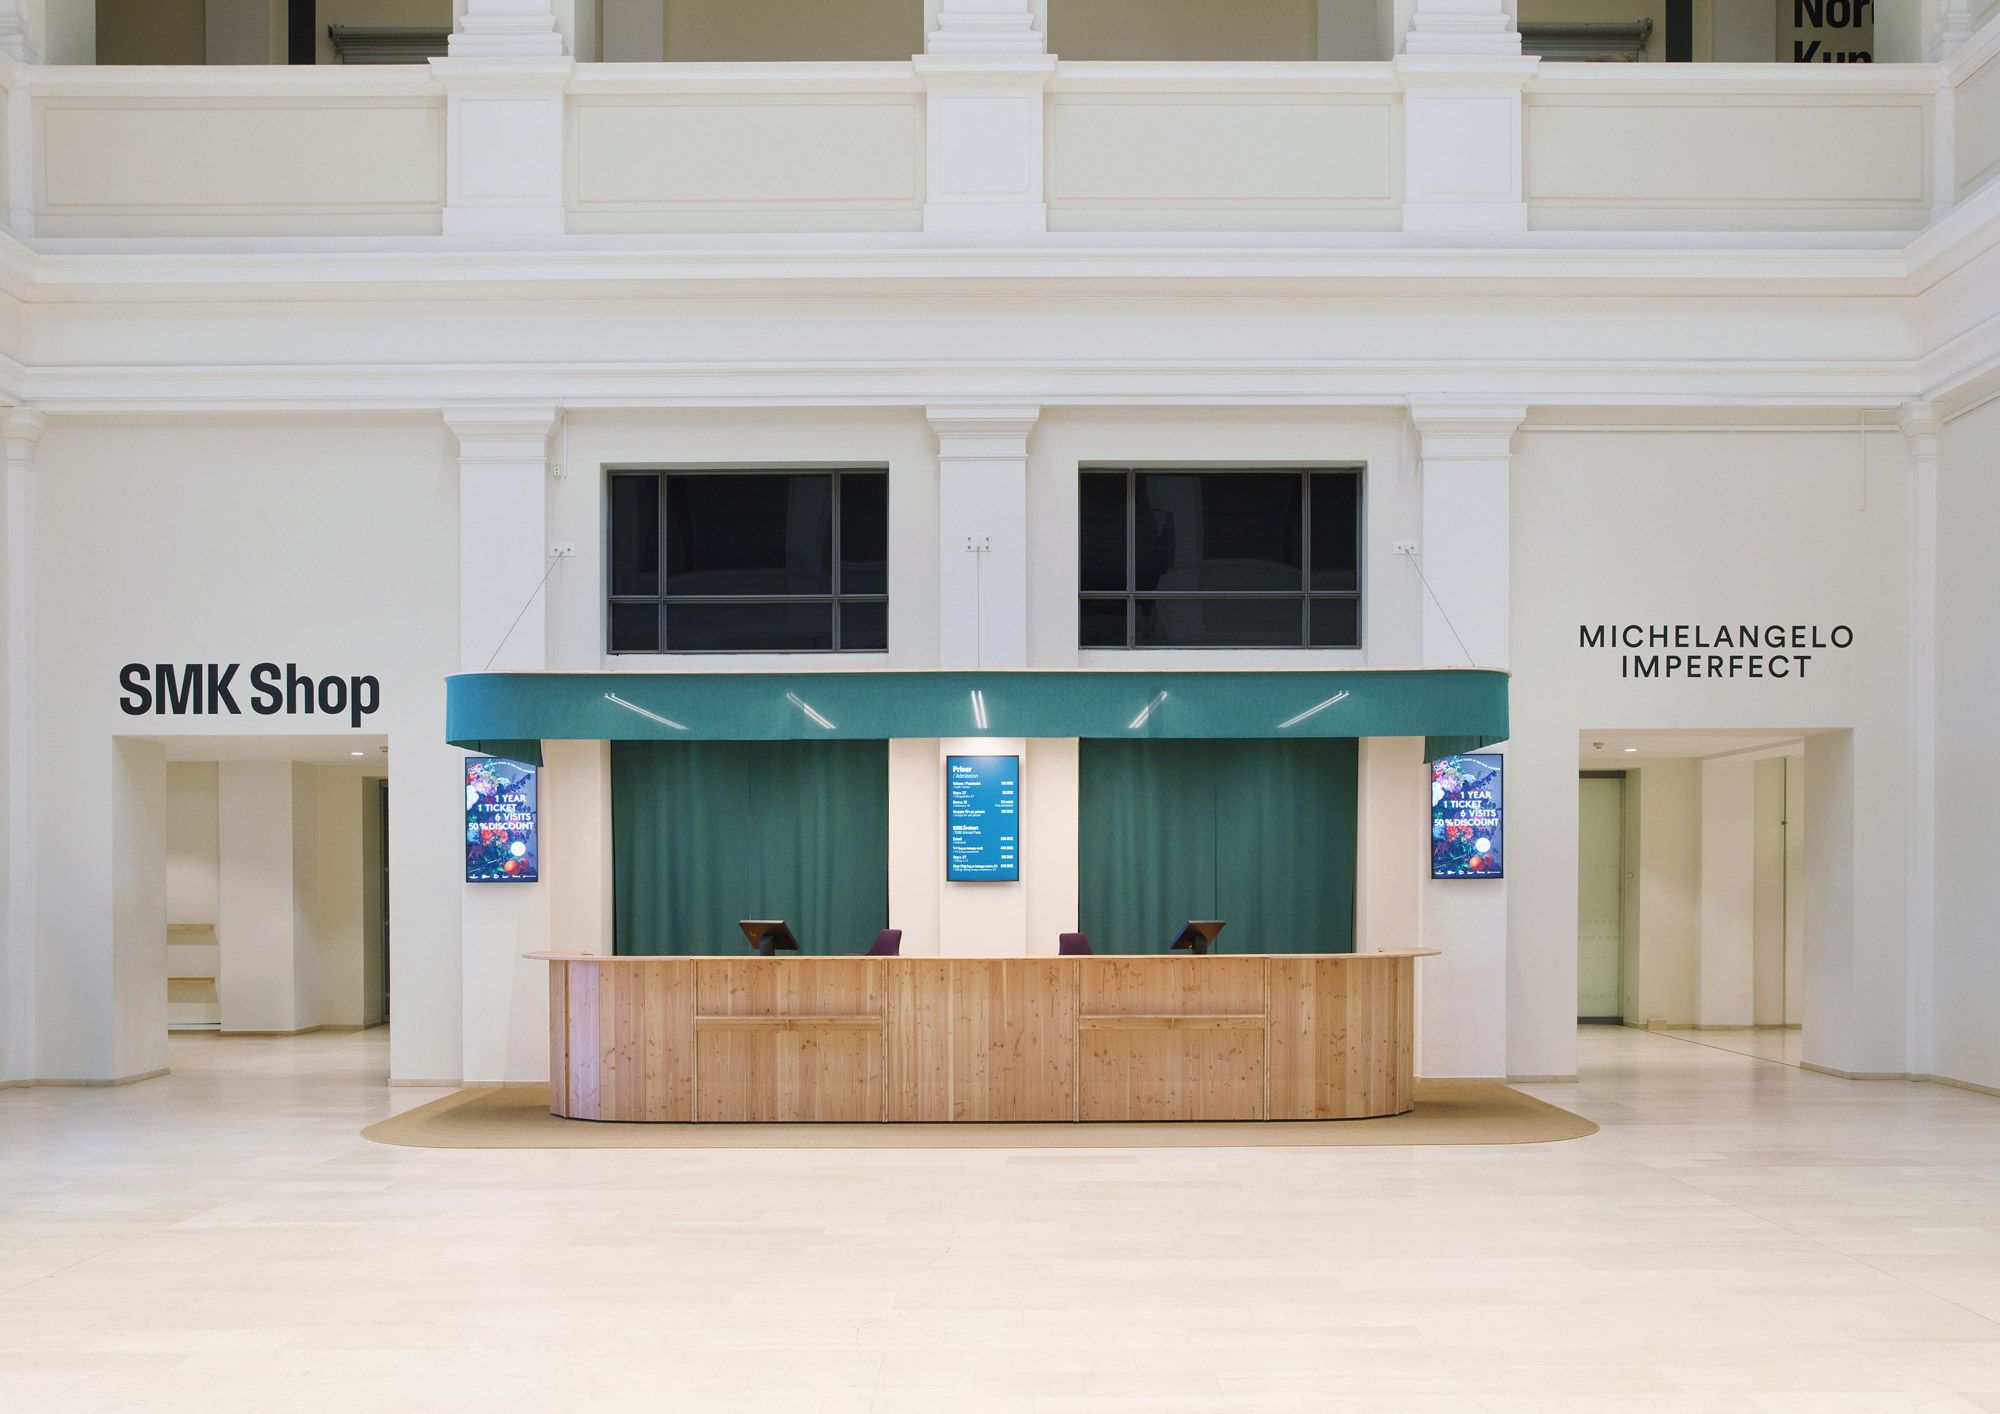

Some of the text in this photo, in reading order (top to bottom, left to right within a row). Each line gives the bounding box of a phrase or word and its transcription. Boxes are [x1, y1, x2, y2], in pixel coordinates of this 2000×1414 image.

[1794, 0, 1874, 28] Nor
[1580, 624, 1853, 648] MICHELANGELO
[1622, 655, 1811, 678] IMPERFECT
[120, 663, 380, 728] SMK Shop
